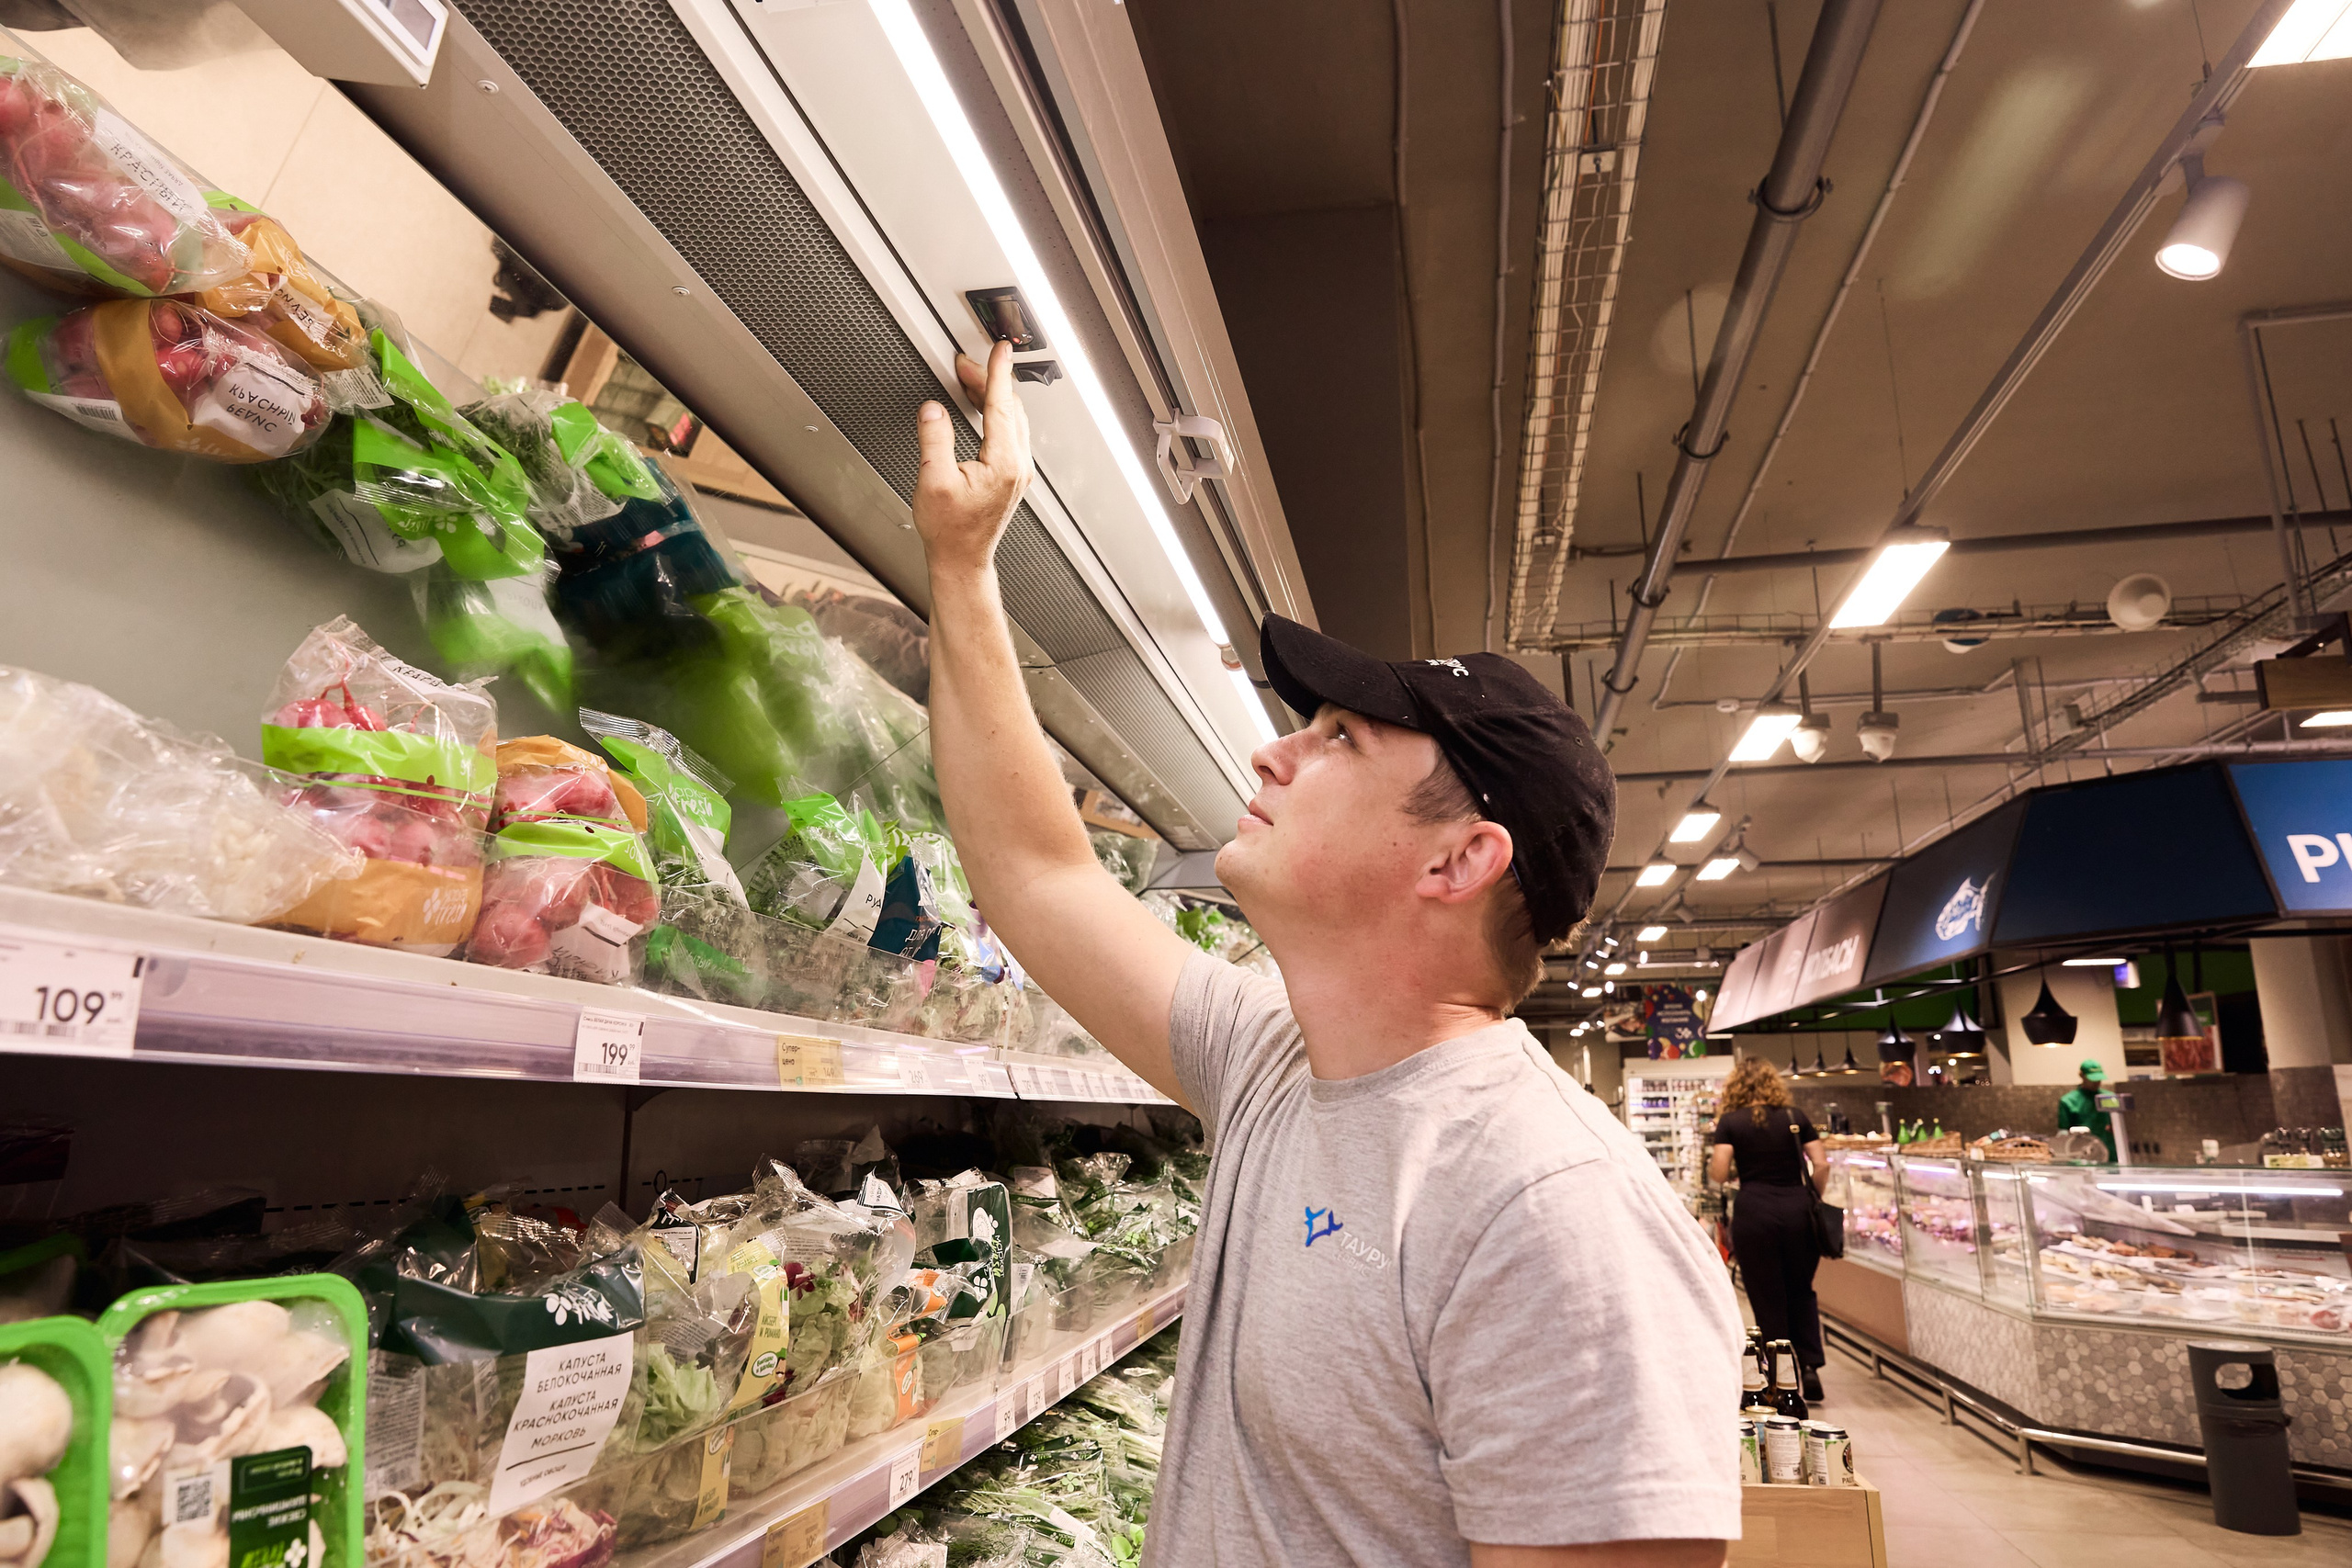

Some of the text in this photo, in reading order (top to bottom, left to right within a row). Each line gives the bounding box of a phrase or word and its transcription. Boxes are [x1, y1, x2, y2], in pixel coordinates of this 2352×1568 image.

[35, 986, 105, 1024] 109
[602, 1042, 628, 1066] 199
[781, 1042, 801, 1055] Супер-
[558, 1352, 606, 1372] КАПУСТА
[537, 1363, 622, 1393] БЕЛОКОЧАННАЯ
[549, 1390, 596, 1412] КАПУСТА
[513, 1398, 619, 1432] КРАСНОКОЧАННАЯ
[530, 1427, 586, 1450] МОРКОВЬ
[899, 1470, 913, 1492] 279
